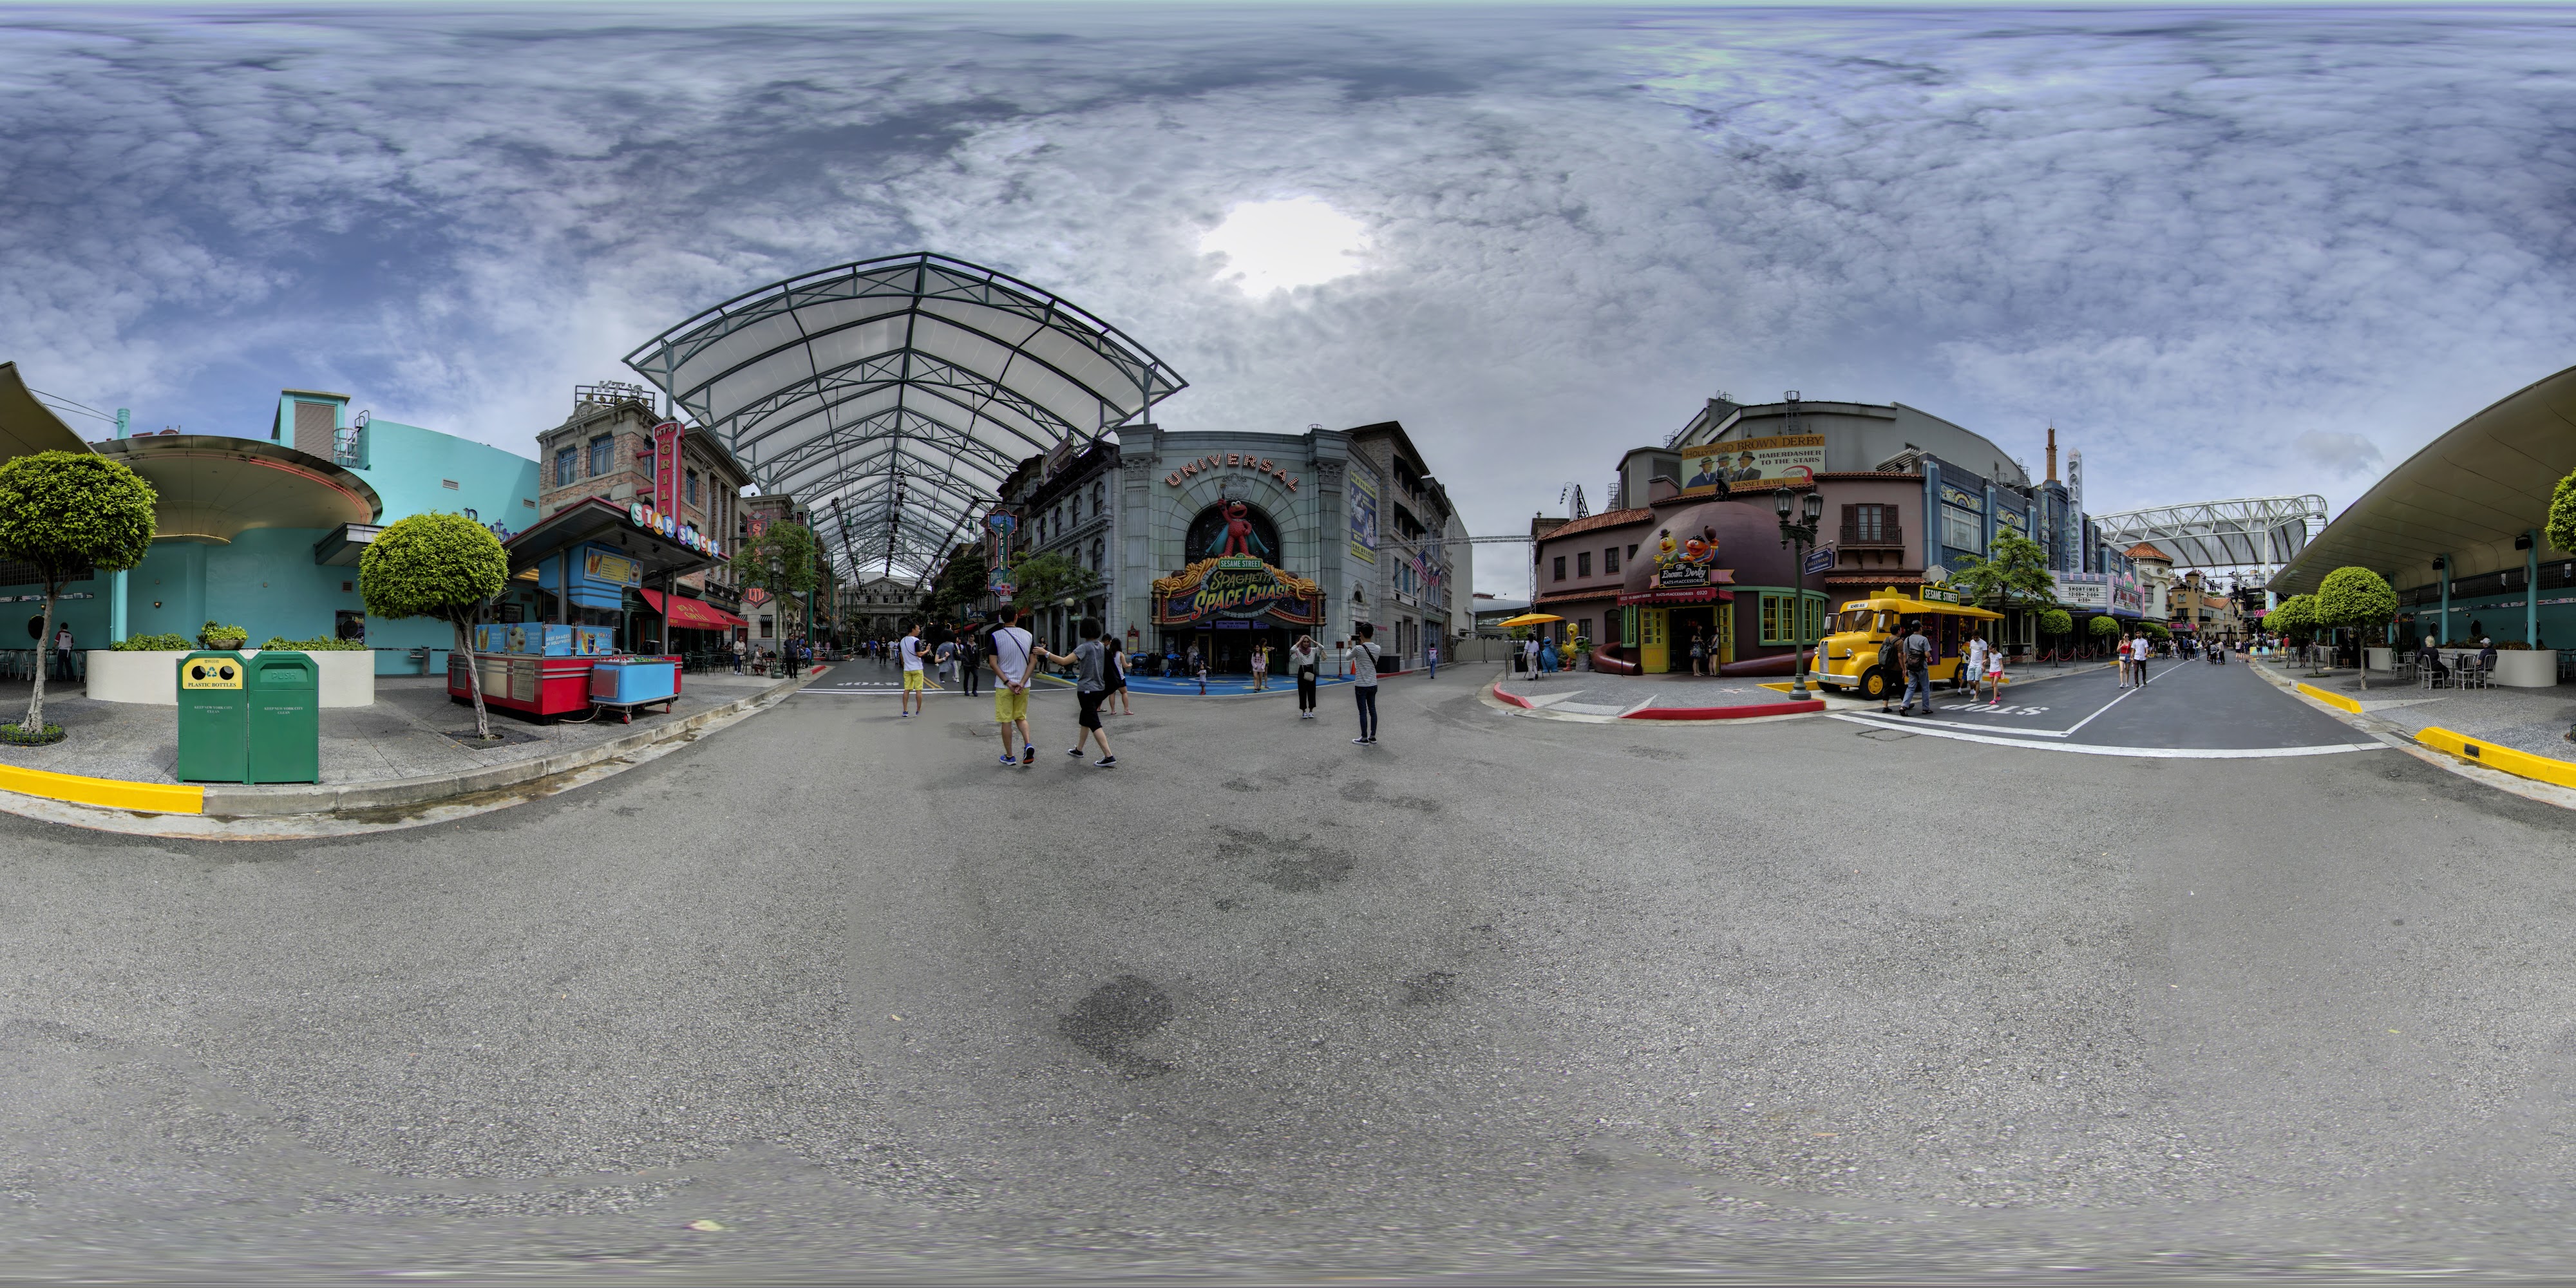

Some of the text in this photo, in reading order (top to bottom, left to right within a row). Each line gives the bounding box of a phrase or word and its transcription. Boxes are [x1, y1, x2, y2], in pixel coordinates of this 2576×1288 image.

[596, 380, 643, 397] KT'S
[1686, 444, 1734, 459] HOLLYWOOD
[1737, 439, 1777, 451] BROWN
[1783, 436, 1823, 446] DERBY
[1759, 450, 1821, 459] HABERDASHER
[660, 444, 670, 516] GRILL
[1165, 453, 1299, 493] UNIVERSAL
[2069, 461, 2079, 568] PANTAGES
[634, 506, 718, 554] STAR SNACKS
[1807, 556, 1829, 567] HOLLYWOOD
[1209, 571, 1273, 592] SPAGHETTI
[1662, 567, 1706, 579] Brown Derby
[748, 588, 764, 602] LTD
[1190, 583, 1291, 621] SPACE CHASE
[1925, 589, 1958, 602] SESAME STREET
[271, 671, 296, 679] PUSH
[1939, 703, 2050, 715] STOP
